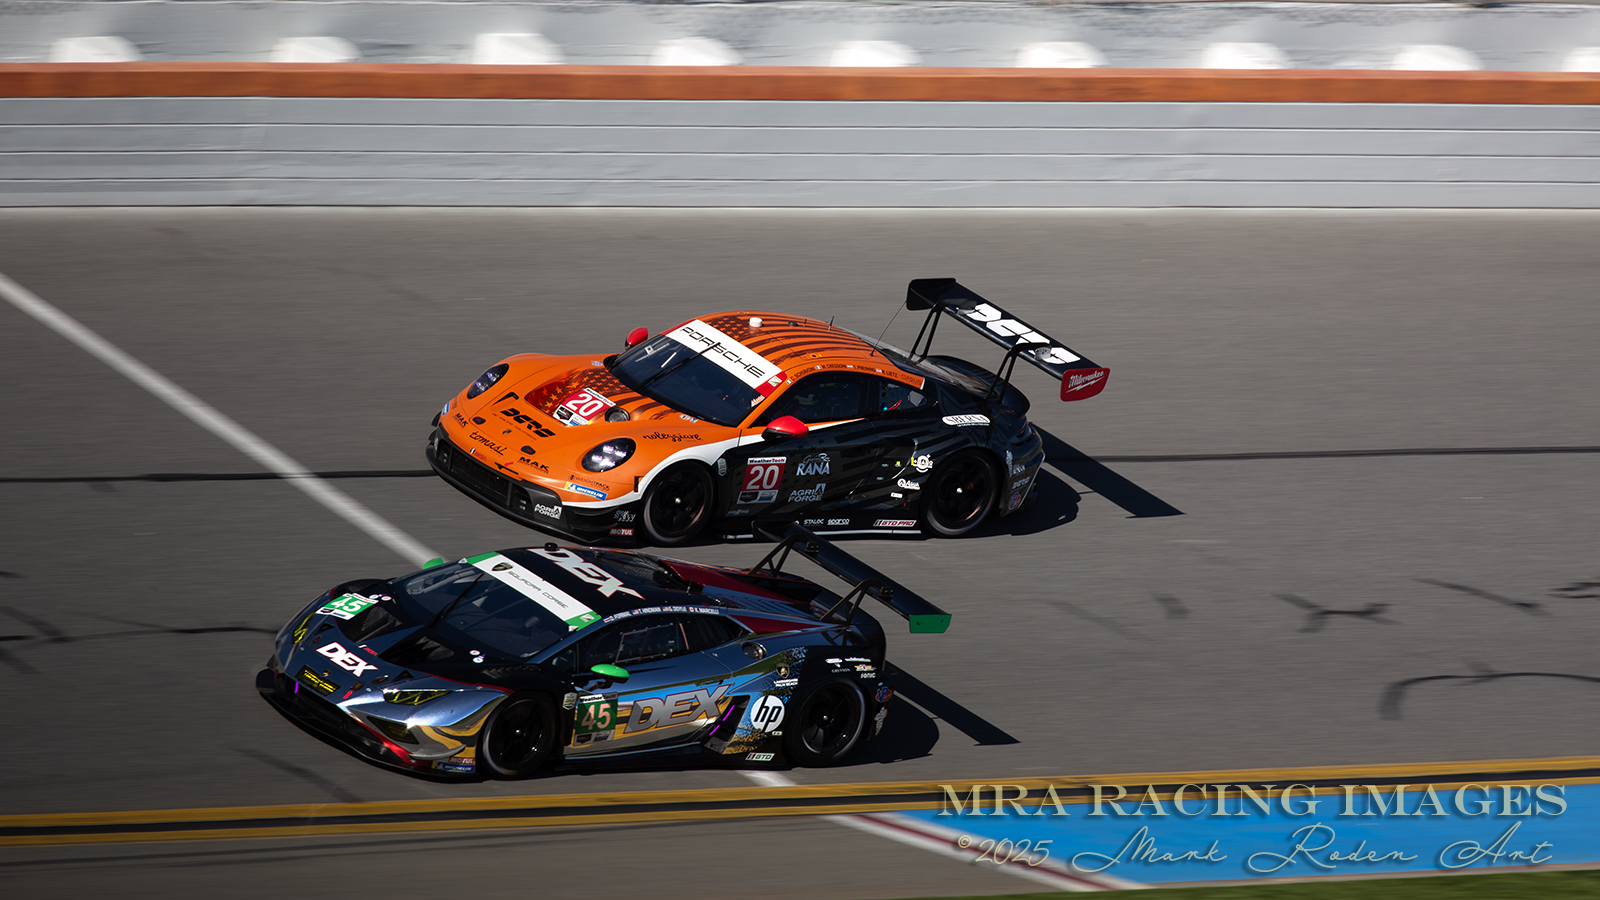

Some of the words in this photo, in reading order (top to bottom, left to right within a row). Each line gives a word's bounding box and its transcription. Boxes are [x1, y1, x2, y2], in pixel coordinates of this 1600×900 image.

[681, 326, 766, 378] PORSCHE
[1068, 370, 1104, 388] Milwaukee
[566, 393, 604, 417] 20
[454, 413, 469, 427] MAK
[469, 430, 507, 456] tomasi
[643, 431, 702, 443] noleggiare
[520, 456, 550, 472] MAK
[796, 461, 830, 476] RANA
[746, 465, 780, 490] 20
[788, 494, 823, 503] FORGE
[609, 528, 633, 536] MOTUL
[527, 548, 646, 600] DEX
[331, 596, 368, 612] 45
[542, 591, 569, 609] CORSE
[315, 642, 379, 678] DEX
[579, 692, 618, 703] WeatherTech
[581, 703, 612, 731] 45
[623, 684, 732, 734] DEX
[753, 694, 783, 734] hp
